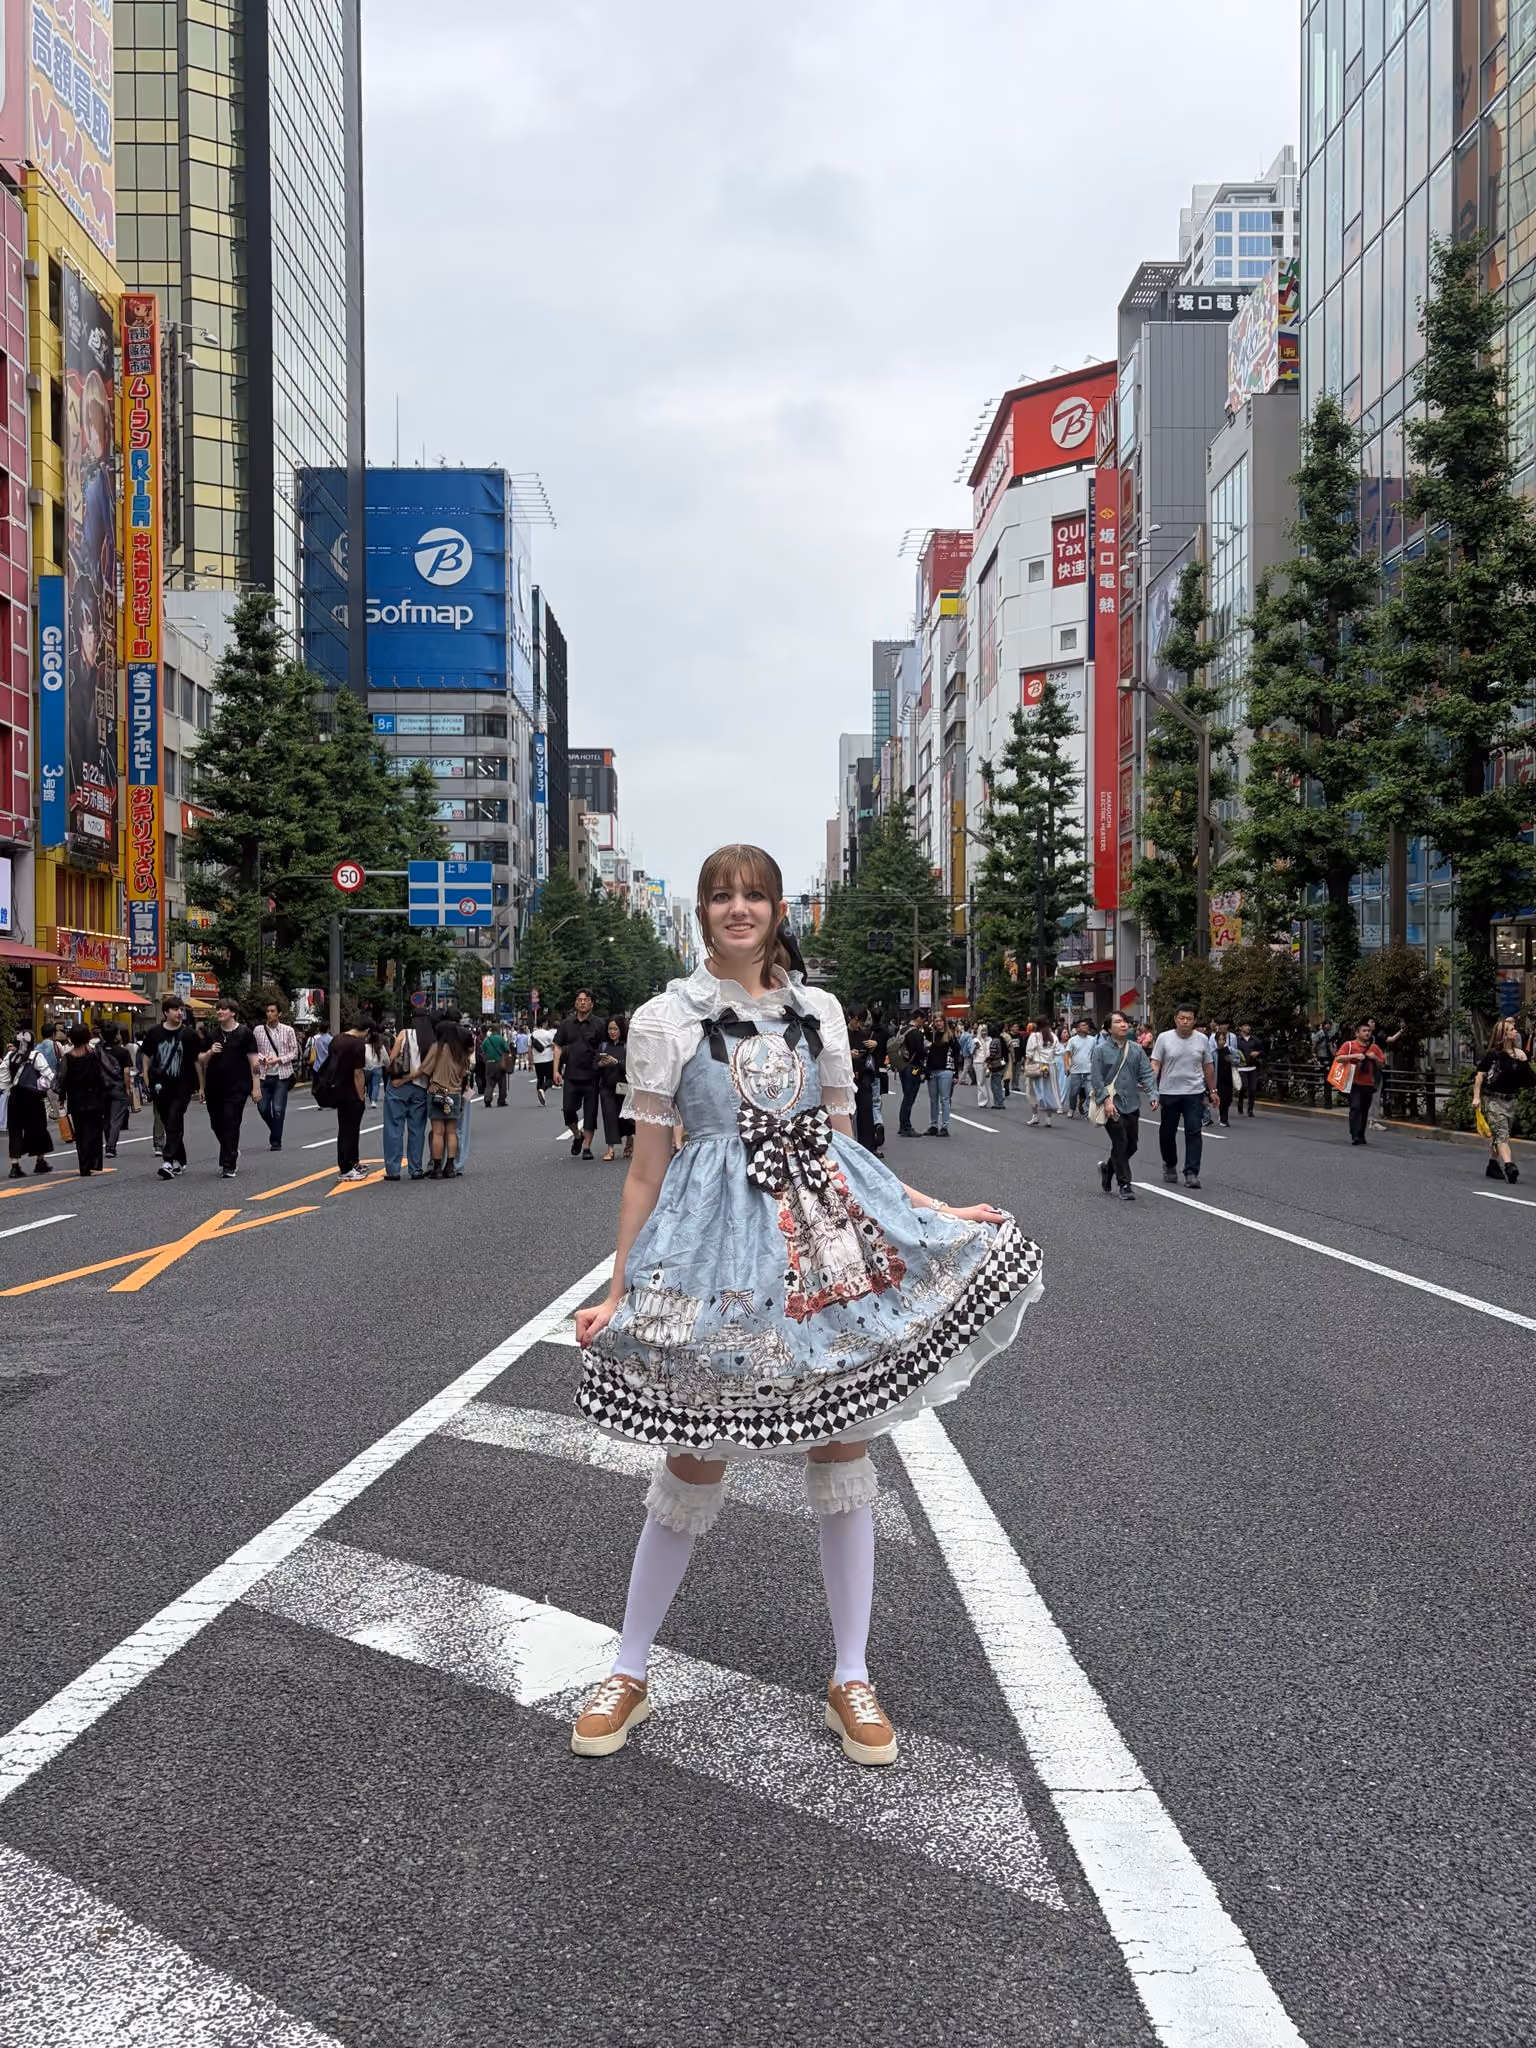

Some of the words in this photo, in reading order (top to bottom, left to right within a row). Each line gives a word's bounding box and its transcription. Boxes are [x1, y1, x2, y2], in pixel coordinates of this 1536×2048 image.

[32, 3, 111, 158] 高額買取
[128, 327, 151, 342] 買取
[1057, 522, 1086, 542] QUI
[1057, 542, 1082, 558] Tax
[1098, 528, 1116, 613] 坂口電熱
[132, 532, 153, 658] 中央通りホビー館
[42, 626, 63, 692] GiGO
[1048, 671, 1068, 681] カメラ
[133, 670, 153, 785] 全フロアホビー
[445, 863, 468, 874] 上野
[340, 870, 358, 884] 50
[132, 901, 157, 913] 2F
[132, 946, 157, 957] フロア
